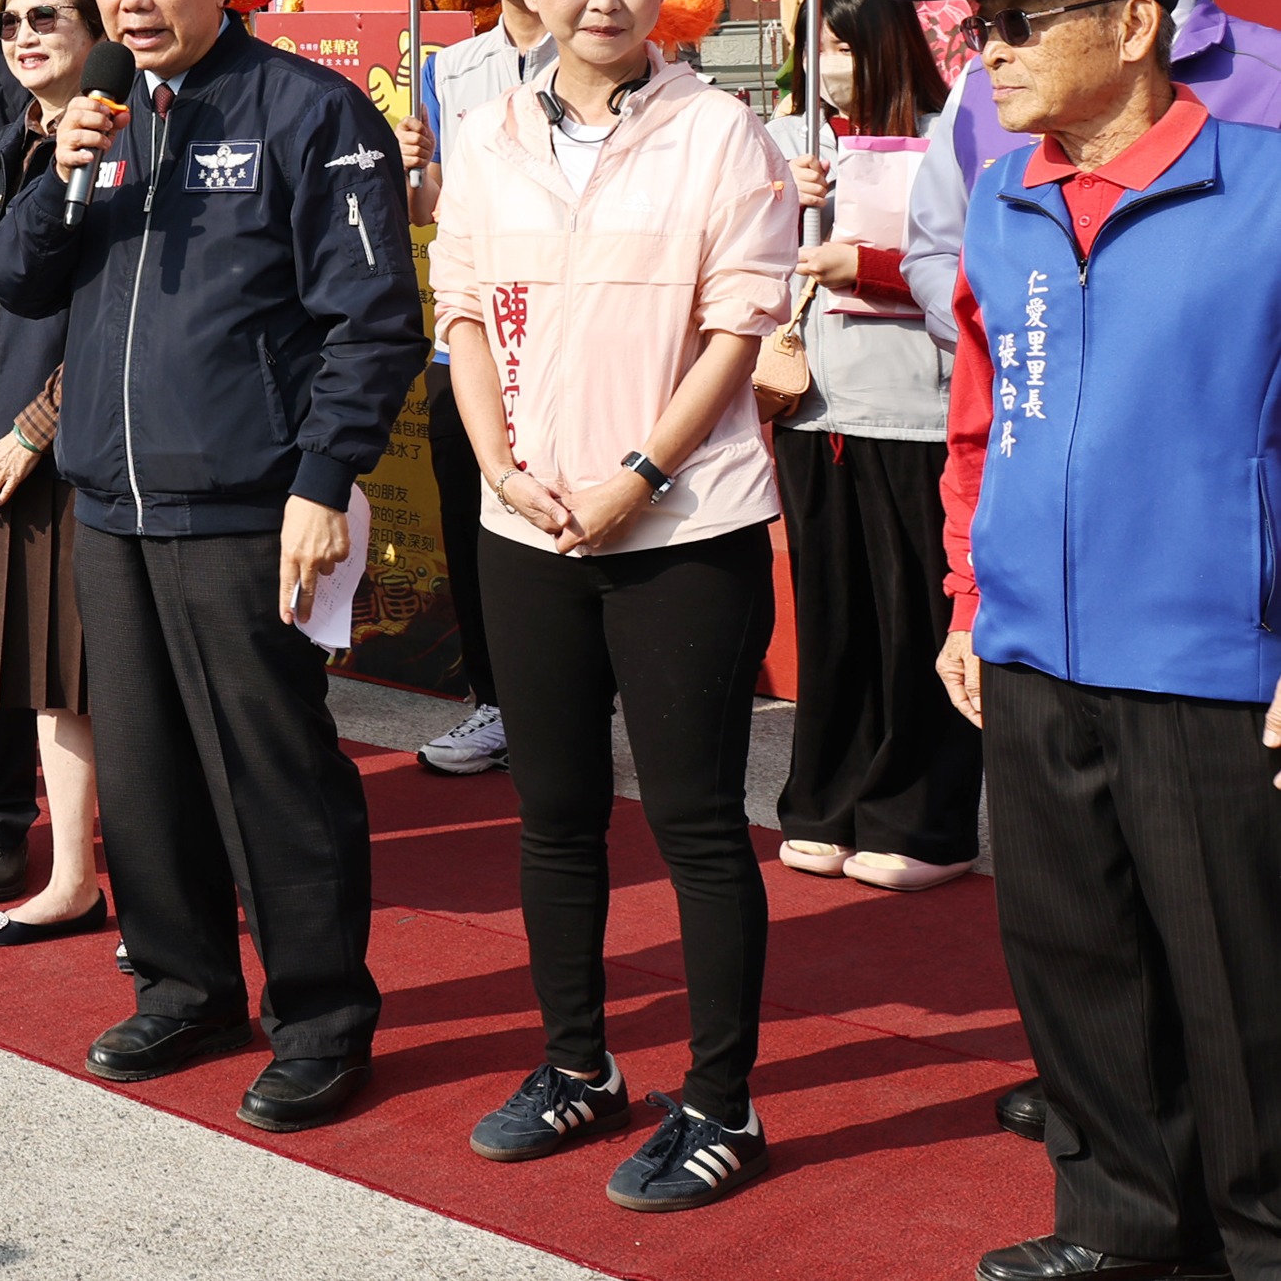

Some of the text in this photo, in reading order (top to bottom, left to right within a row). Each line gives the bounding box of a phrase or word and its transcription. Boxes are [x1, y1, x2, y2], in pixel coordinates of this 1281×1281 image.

[319, 39, 360, 56] 保華宮
[997, 332, 1021, 458] 張台昇
[1020, 270, 1050, 420] 仁愛里里長
